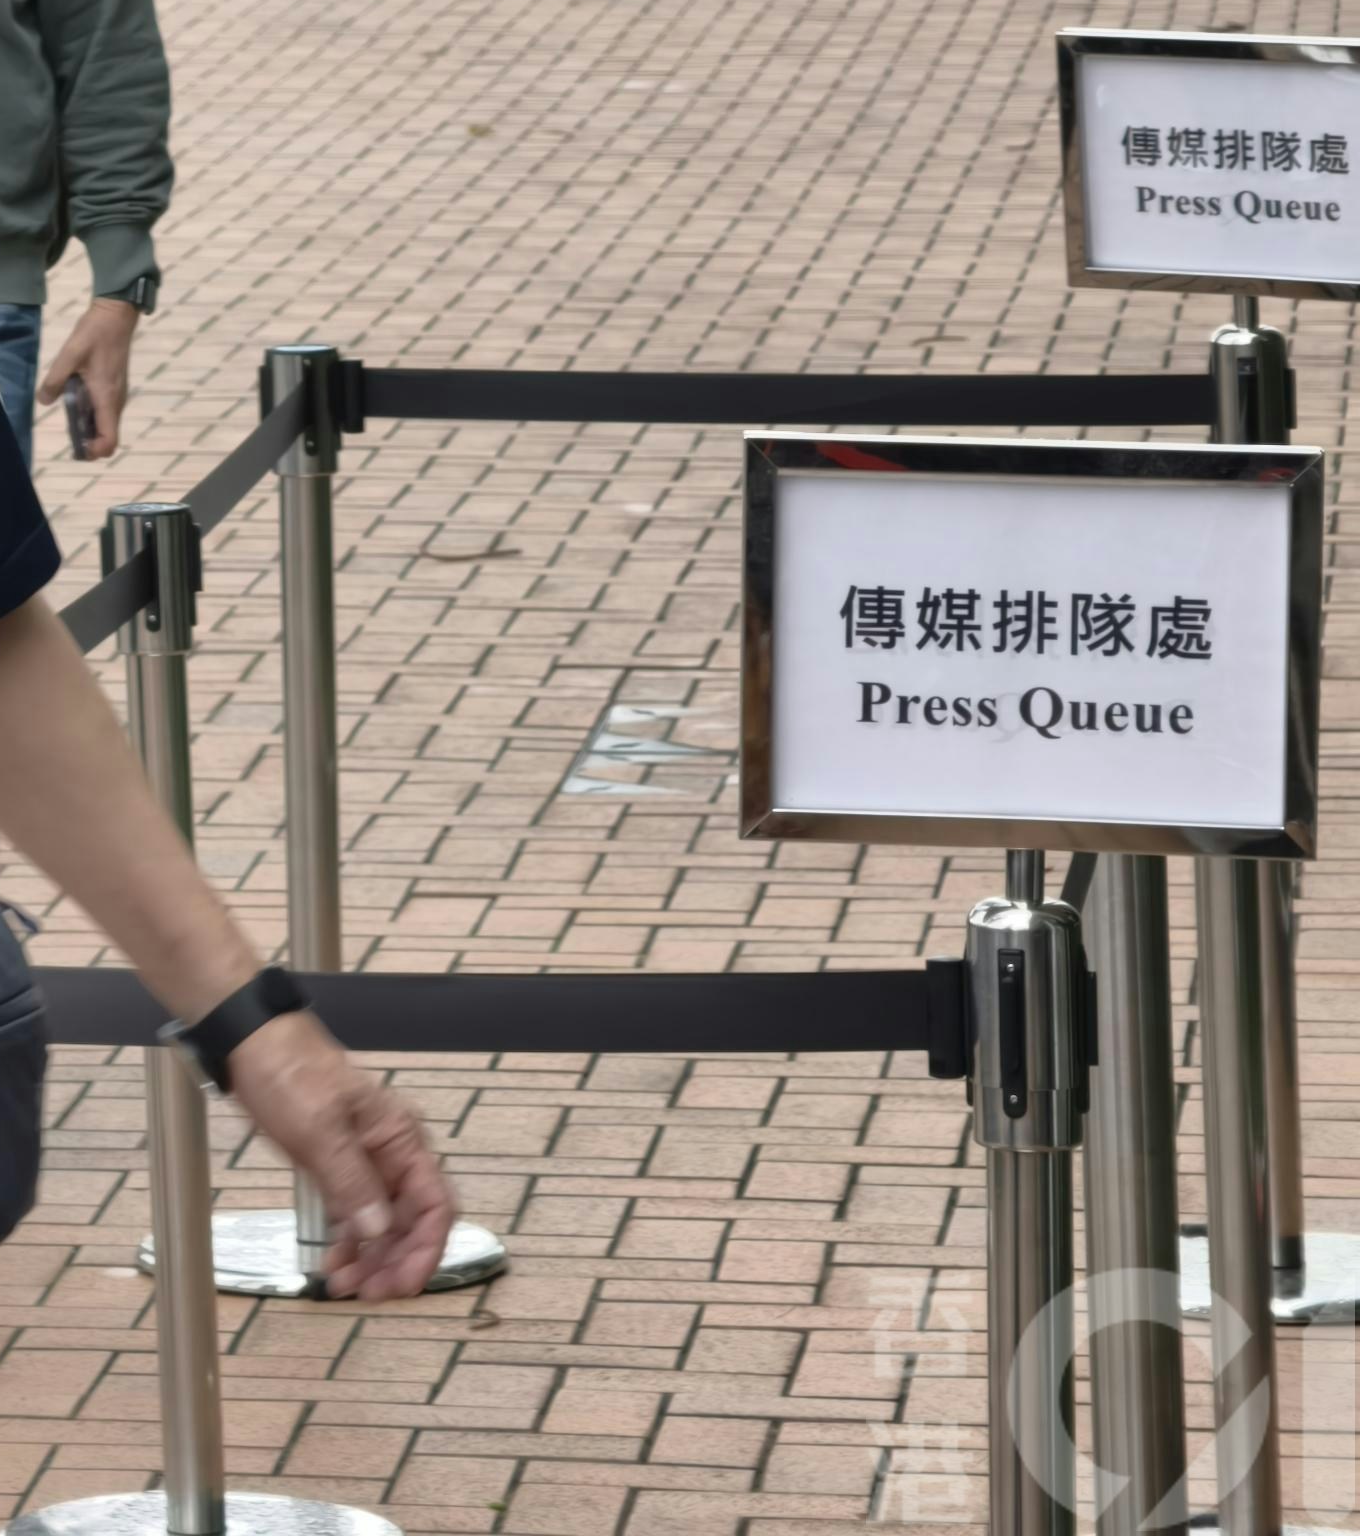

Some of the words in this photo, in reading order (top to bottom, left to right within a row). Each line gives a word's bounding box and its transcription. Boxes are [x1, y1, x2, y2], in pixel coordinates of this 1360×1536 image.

[1120, 125, 1350, 175] 傳媒排隊處
[1135, 185, 1223, 218] Press
[1232, 190, 1342, 225] Queue
[838, 584, 1213, 661] 傳媒排隊處
[855, 681, 999, 728] Press
[1017, 686, 1195, 740] Queue
